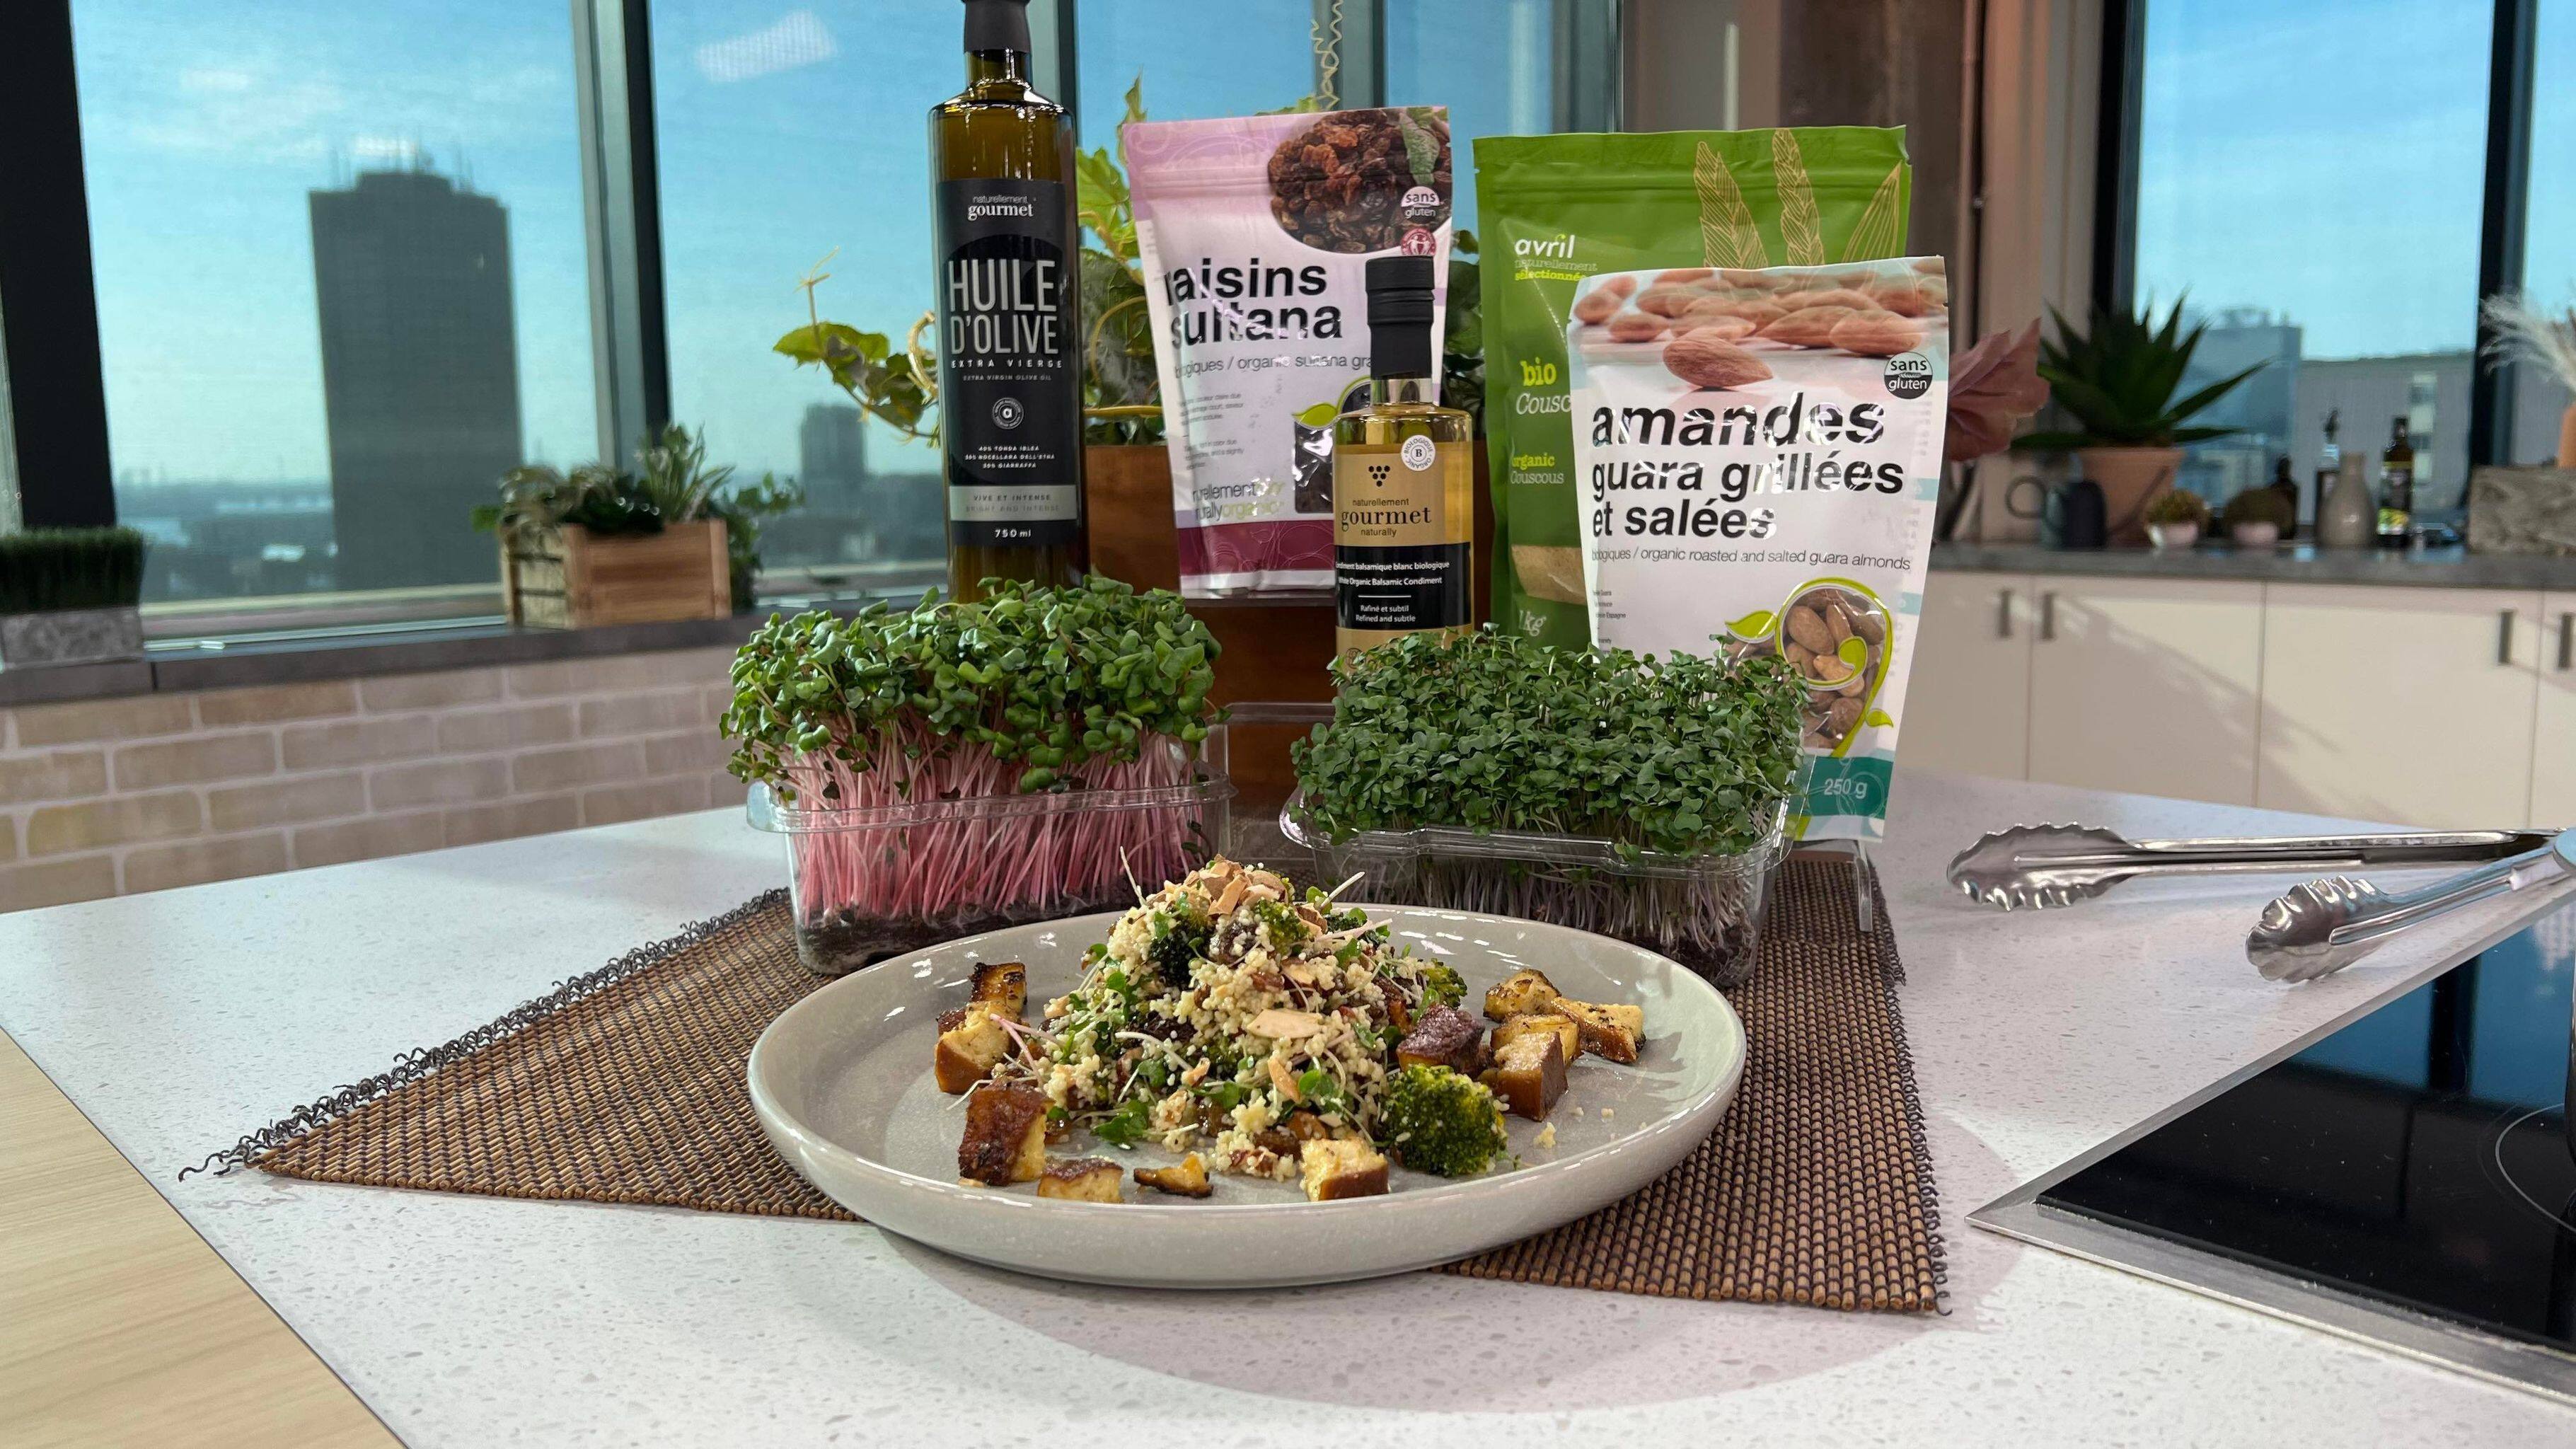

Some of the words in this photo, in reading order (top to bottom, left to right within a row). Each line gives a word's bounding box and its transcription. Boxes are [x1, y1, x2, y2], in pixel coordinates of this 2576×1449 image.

[1406, 193, 1436, 203] sans
[968, 204, 1034, 221] gourmet
[1405, 207, 1436, 219] gluten
[1514, 233, 1576, 258] avril
[948, 258, 1057, 312] HUILE
[1163, 258, 1327, 306] raisins
[950, 314, 1058, 354] D'OLIVE
[1171, 304, 1342, 350] sultana
[951, 359, 995, 369] EXTRA
[1007, 359, 1062, 369] VIERGE
[1520, 356, 1556, 386] bio
[1890, 358, 1928, 372] sans
[1888, 376, 1927, 393] gluten
[1592, 391, 1885, 448] amandes
[1415, 449, 1422, 457] B
[1511, 451, 1555, 473] organic
[1511, 469, 1564, 485] Couscous
[1592, 458, 1704, 502] guara
[1720, 449, 1905, 502] grillées
[1352, 498, 1409, 507] naturellement
[1341, 507, 1432, 532] gourmet
[1592, 500, 1613, 538] et
[1624, 497, 1777, 540] salées
[994, 529, 1017, 538] 750
[1020, 529, 1032, 538] ml
[1361, 528, 1397, 538] naturally
[1356, 562, 1392, 572] balsamique
[1414, 562, 1450, 571] biologique
[1641, 547, 1686, 562] organic
[1690, 548, 1738, 562] roasted
[1740, 549, 1764, 563] and
[1767, 549, 1806, 564] salted
[1810, 552, 1849, 567] guara
[1852, 553, 1911, 570] almonds
[1349, 577, 1372, 587] Organic
[1372, 577, 1403, 586] Balsamic
[1404, 577, 1443, 586] Condiment
[1356, 614, 1378, 623] Refined
[1380, 614, 1392, 623] and
[1824, 780, 1851, 796] 250
[1855, 781, 1868, 798] g
